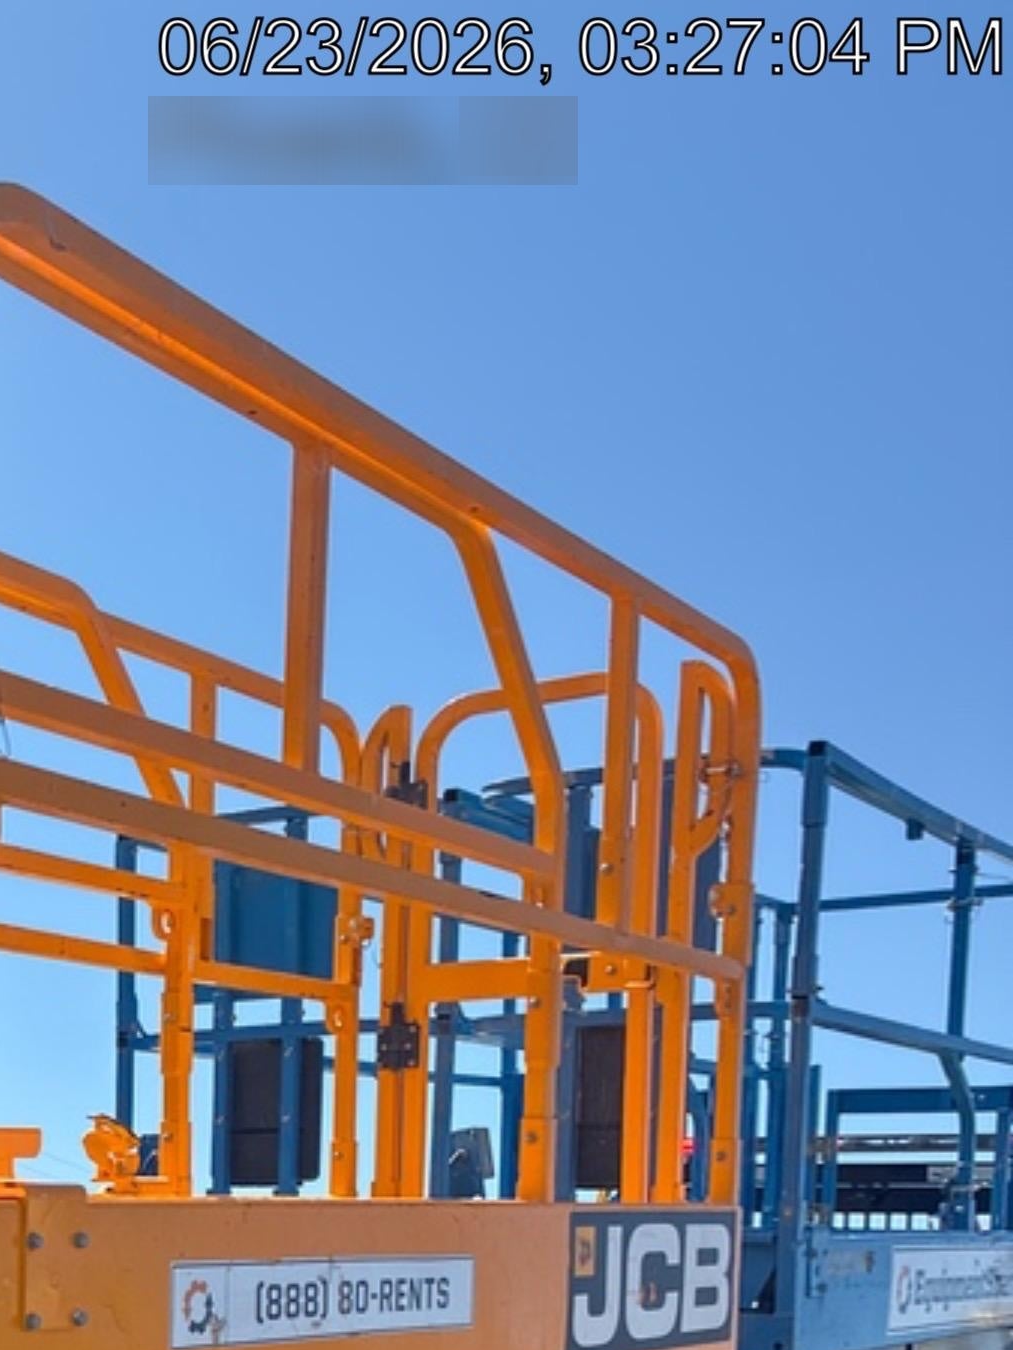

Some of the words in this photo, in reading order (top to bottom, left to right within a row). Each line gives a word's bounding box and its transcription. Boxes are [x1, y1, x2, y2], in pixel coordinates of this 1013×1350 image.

[256, 1277, 328, 1325] (888)
[338, 1276, 451, 1315] 80-RENTS
[572, 1222, 731, 1347] JCB
